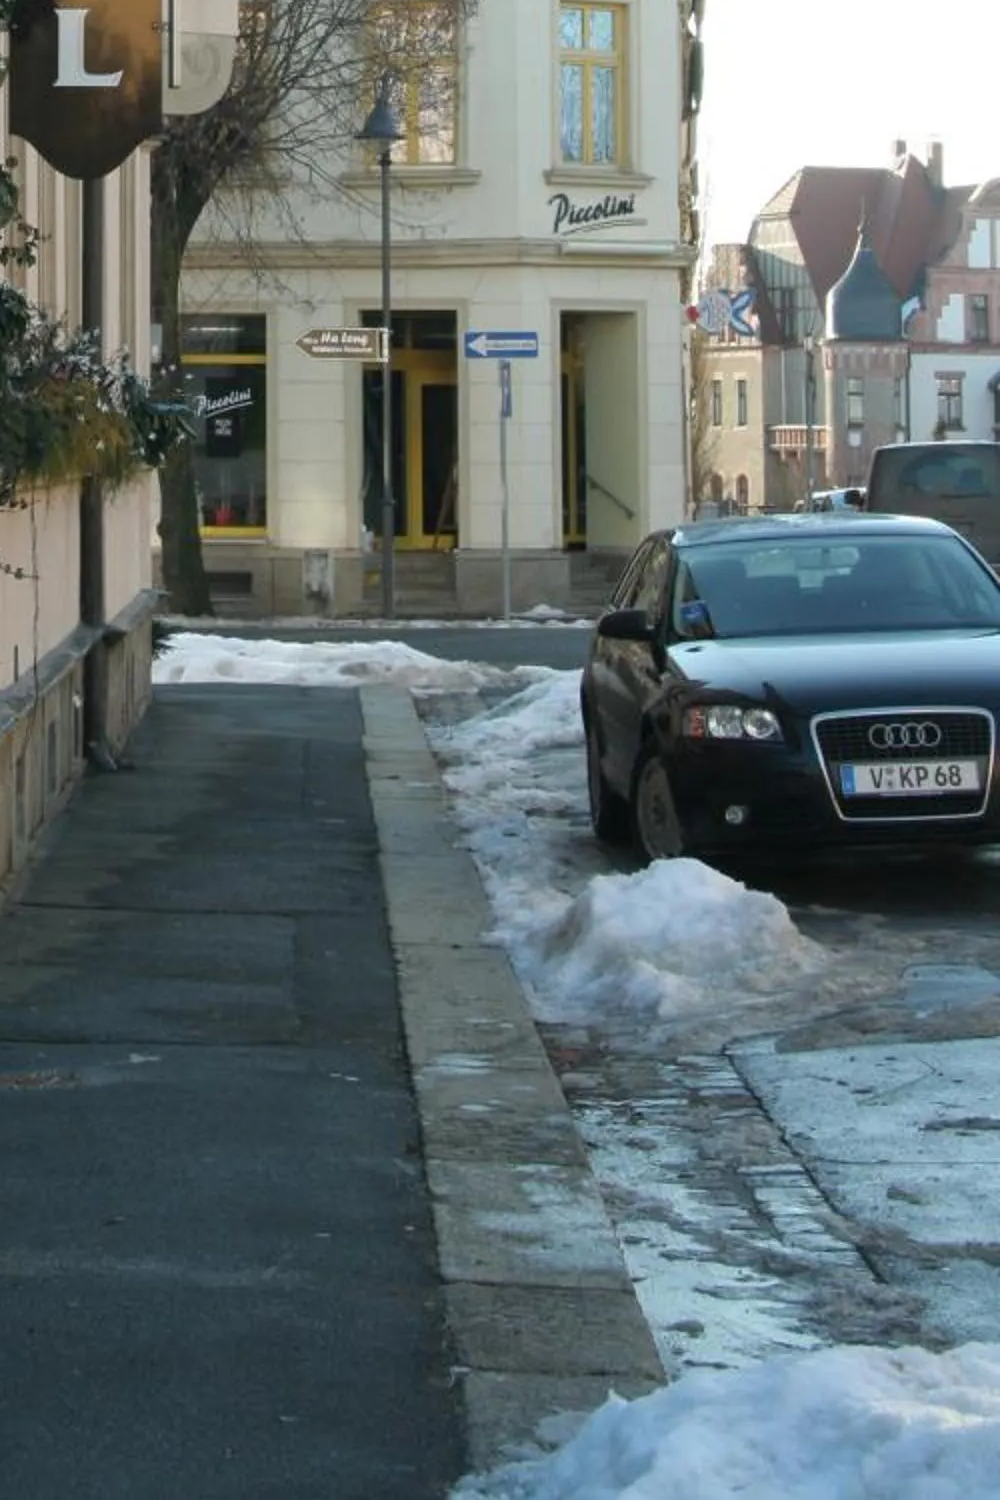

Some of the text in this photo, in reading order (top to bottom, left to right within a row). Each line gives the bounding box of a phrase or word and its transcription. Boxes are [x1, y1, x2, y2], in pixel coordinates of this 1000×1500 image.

[547, 192, 635, 234] Piccolini
[195, 388, 251, 417] Piccolini
[899, 765, 928, 789] KP
[935, 764, 962, 787] 68
